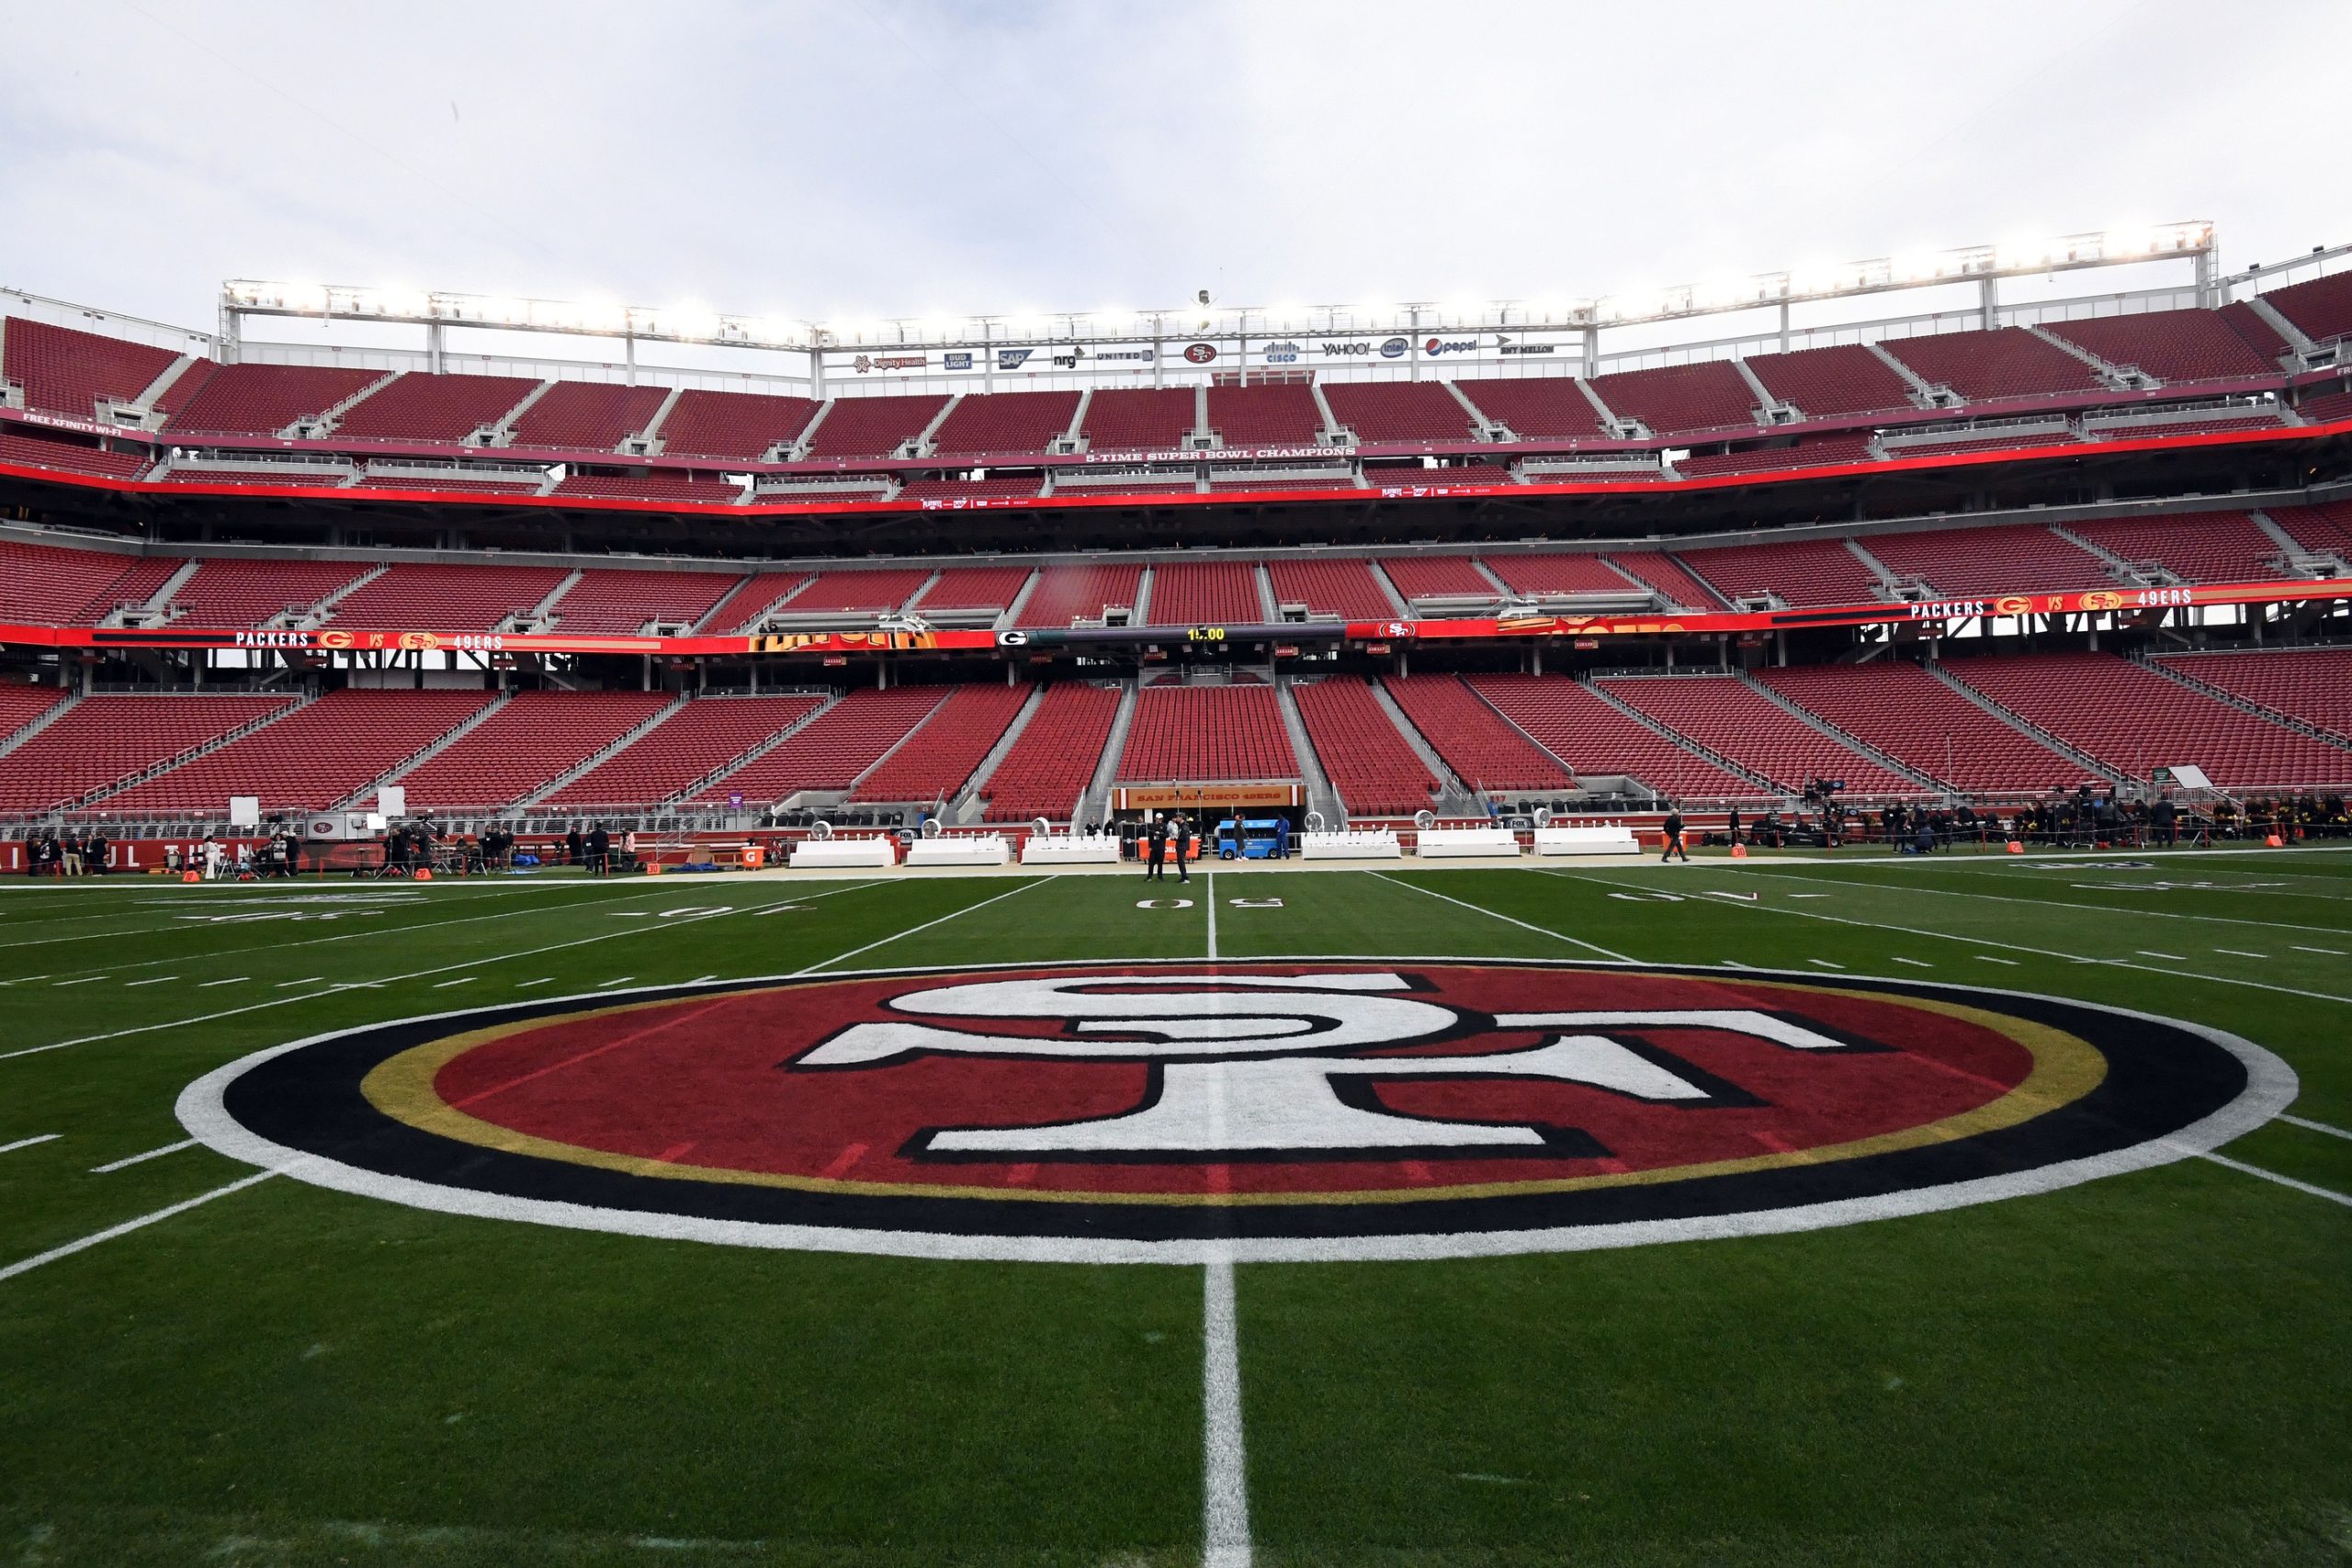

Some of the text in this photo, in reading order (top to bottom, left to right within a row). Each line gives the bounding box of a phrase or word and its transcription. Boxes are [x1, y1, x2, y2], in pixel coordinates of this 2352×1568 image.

[1322, 343, 1371, 356] YAHOO!
[1384, 342, 1405, 352] intel
[1443, 340, 1477, 354] pepsi
[1500, 345, 1555, 355] BNY MELLON
[875, 358, 926, 369] Dignity Health
[1000, 354, 1024, 366] SAP
[1054, 355, 1076, 368] nrg
[2337, 365, 2352, 376] FR
[23, 413, 122, 436] FREE XFINITY WI-FI
[1086, 447, 1356, 462] 5-TIME SUPER BOWL CHAMPIONS
[2047, 596, 2063, 611] VS
[2138, 589, 2192, 606] 49ERS
[1911, 600, 1984, 619] PACKERS
[236, 631, 309, 647] PACKERS
[369, 634, 384, 647] VS
[454, 635, 503, 649] 49ERS
[1168, 794, 1239, 802] FRANCISCO
[745, 851, 756, 862] G
[1736, 847, 1747, 856] 30
[415, 869, 426, 878] 20
[648, 864, 658, 873] 30
[796, 972, 1848, 1152] SF
